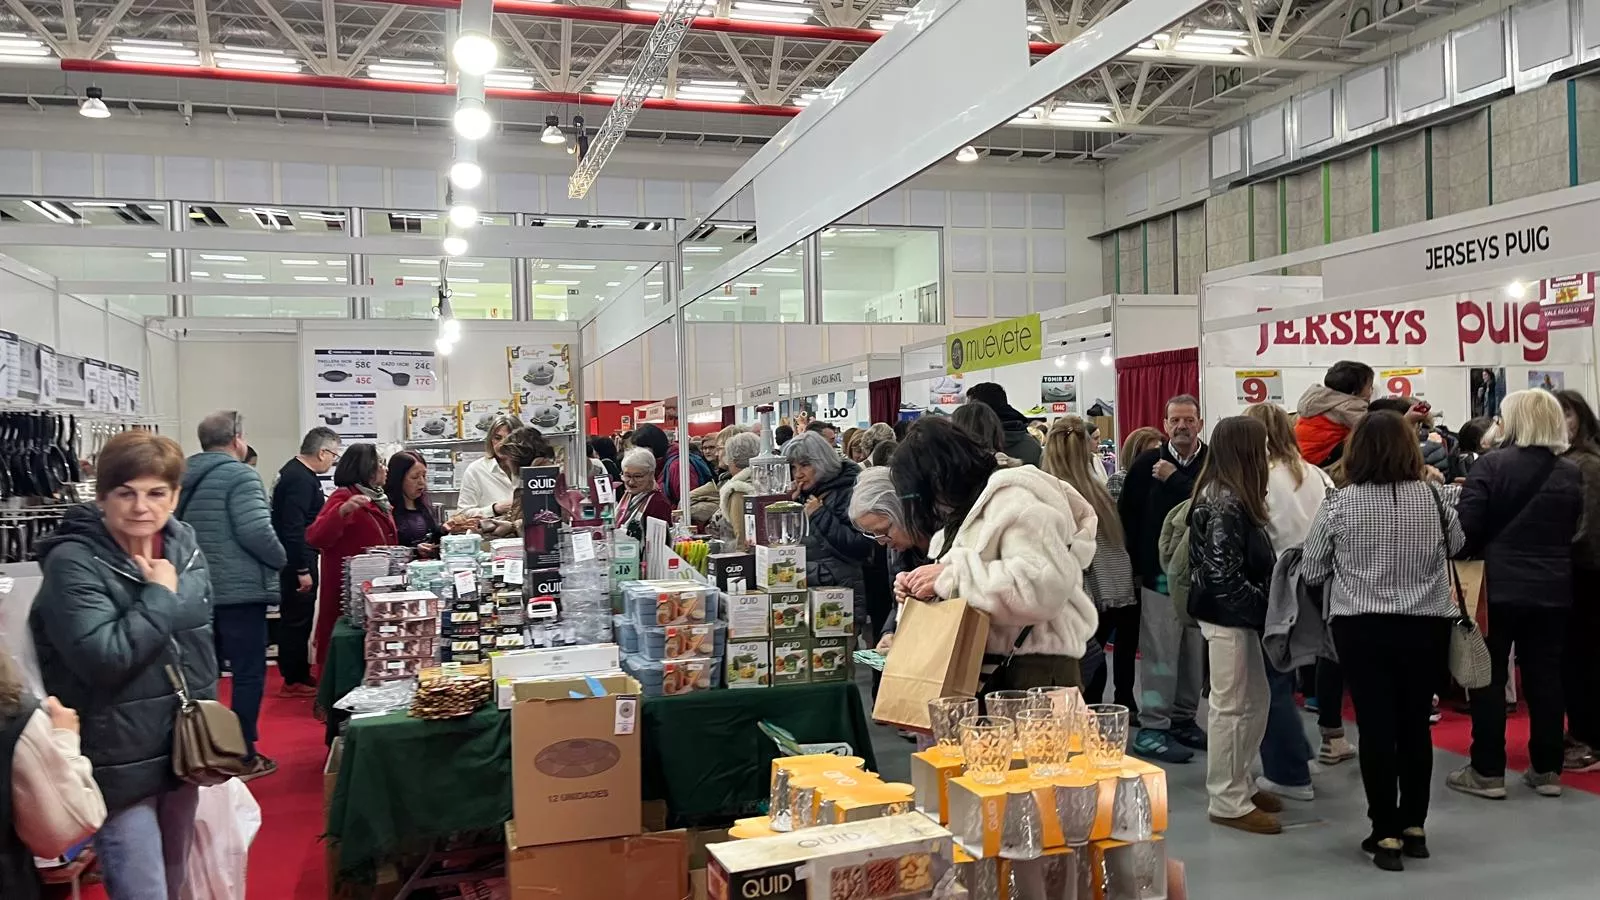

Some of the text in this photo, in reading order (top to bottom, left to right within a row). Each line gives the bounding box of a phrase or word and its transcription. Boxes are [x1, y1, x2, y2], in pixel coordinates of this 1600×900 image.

[1425, 225, 1550, 271] JERSEYS PUIG
[1256, 300, 1549, 362] JERSEYS puig
[966, 322, 1032, 362] muévete
[355, 361, 371, 369] 58€
[415, 362, 431, 370] 24€
[1242, 378, 1268, 403] 9
[1387, 376, 1411, 398] 9
[527, 478, 556, 490] QUID
[778, 548, 796, 557] QUID
[725, 565, 743, 574] QUID
[537, 581, 561, 593] QUI
[740, 596, 758, 605] QUID
[781, 594, 800, 603] QUID
[826, 592, 845, 600] QUID
[819, 638, 838, 646] QUID
[739, 644, 758, 652] QUID
[797, 832, 863, 849] QUID
[742, 873, 793, 899] QUID
